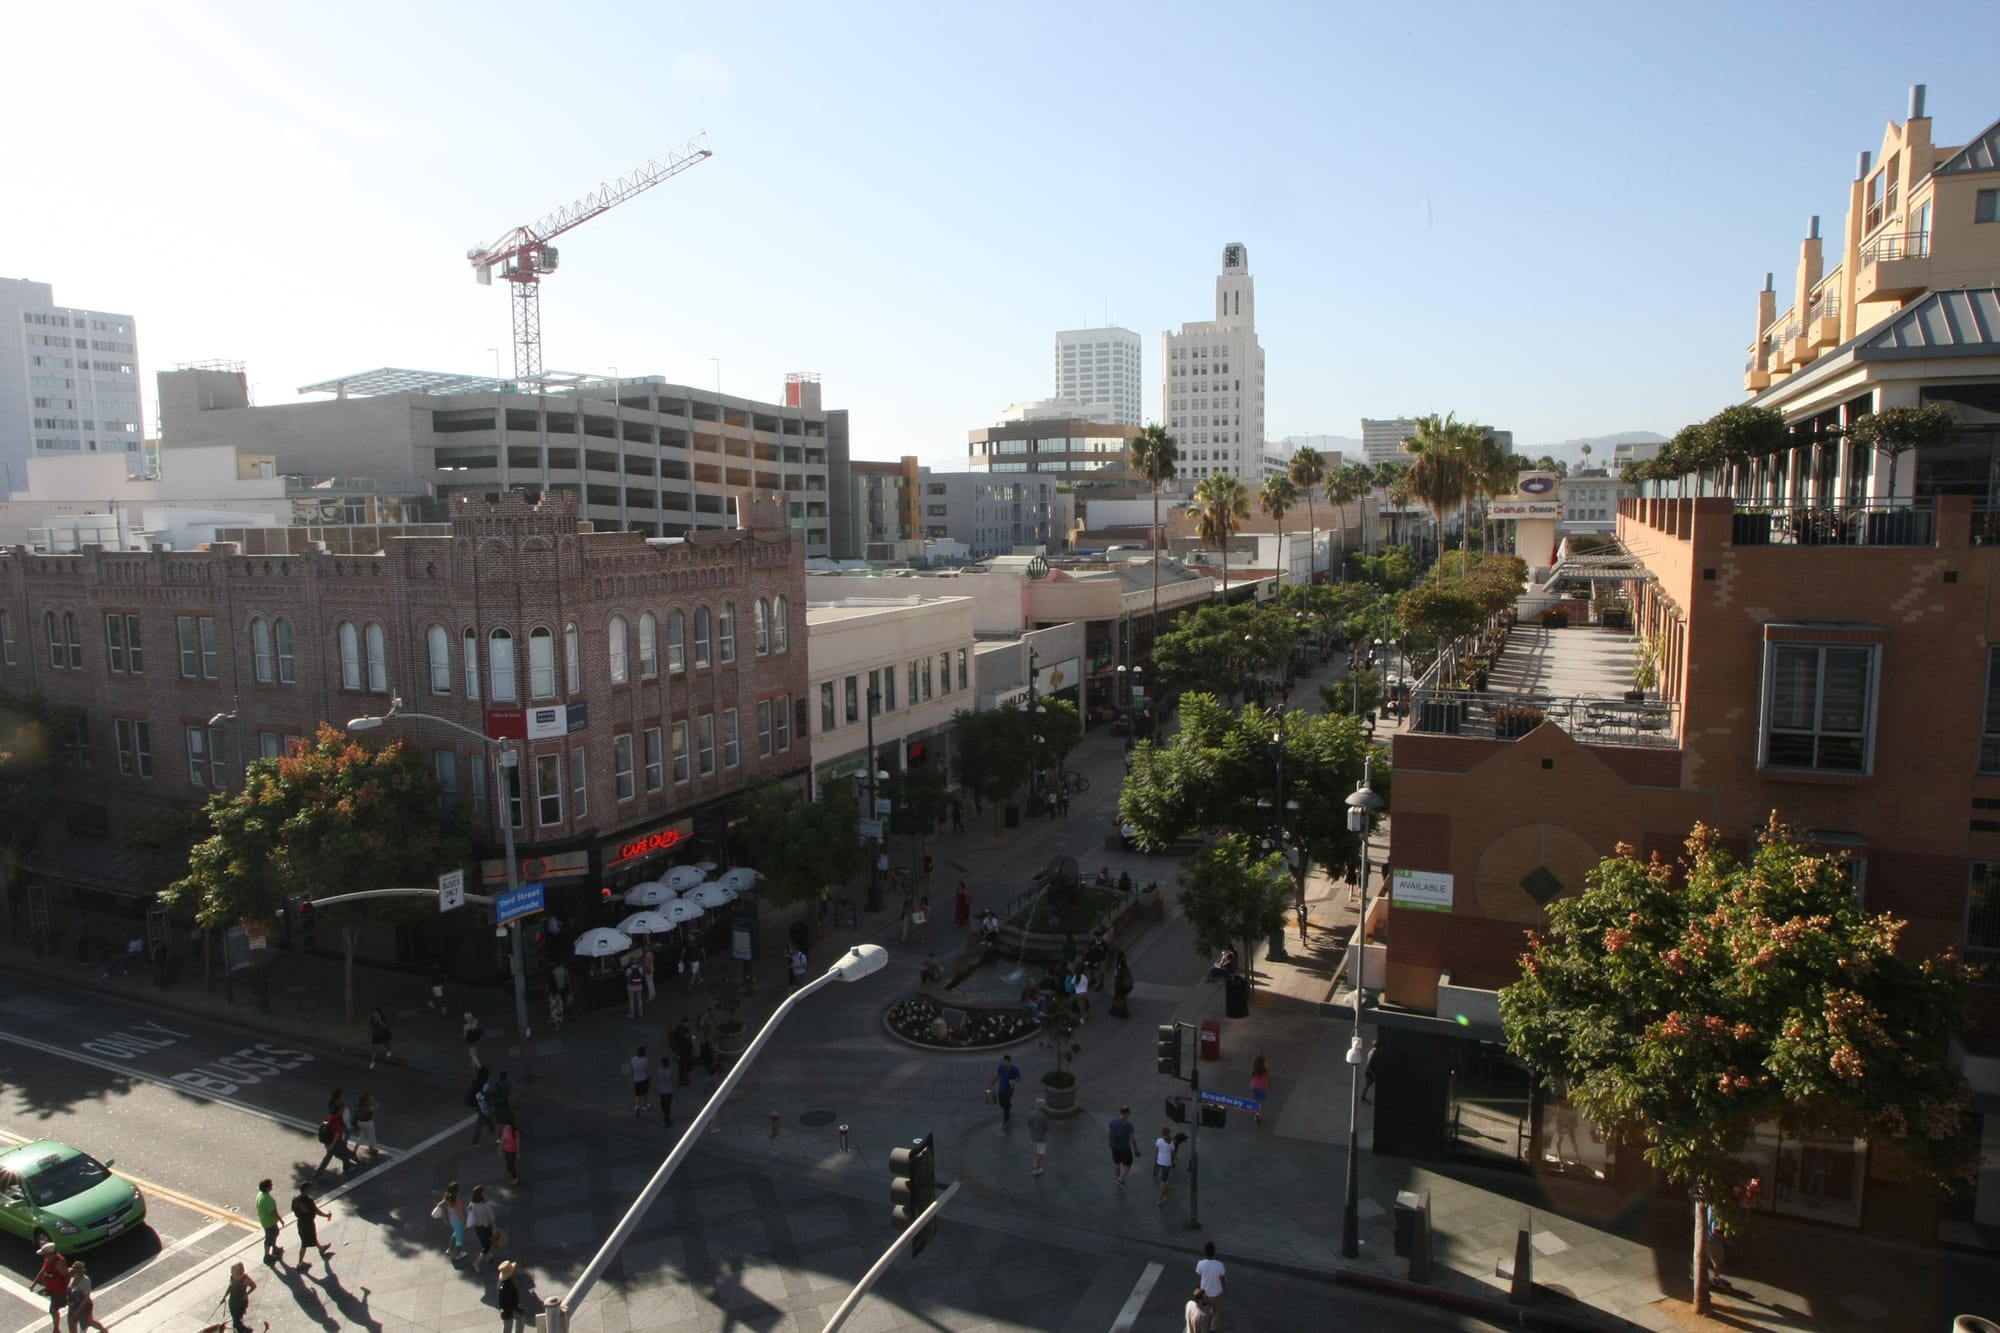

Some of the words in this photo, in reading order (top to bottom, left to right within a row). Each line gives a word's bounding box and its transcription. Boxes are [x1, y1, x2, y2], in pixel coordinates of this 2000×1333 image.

[444, 888, 458, 898] ONLY
[1400, 880, 1447, 893] AVAILABLE
[498, 895, 516, 909] Third
[516, 889, 540, 901] Street
[500, 901, 540, 919] Promenade
[80, 1020, 192, 1059] ONLY
[169, 1043, 315, 1096] BUSES
[1201, 1091, 1243, 1108] Broadway
